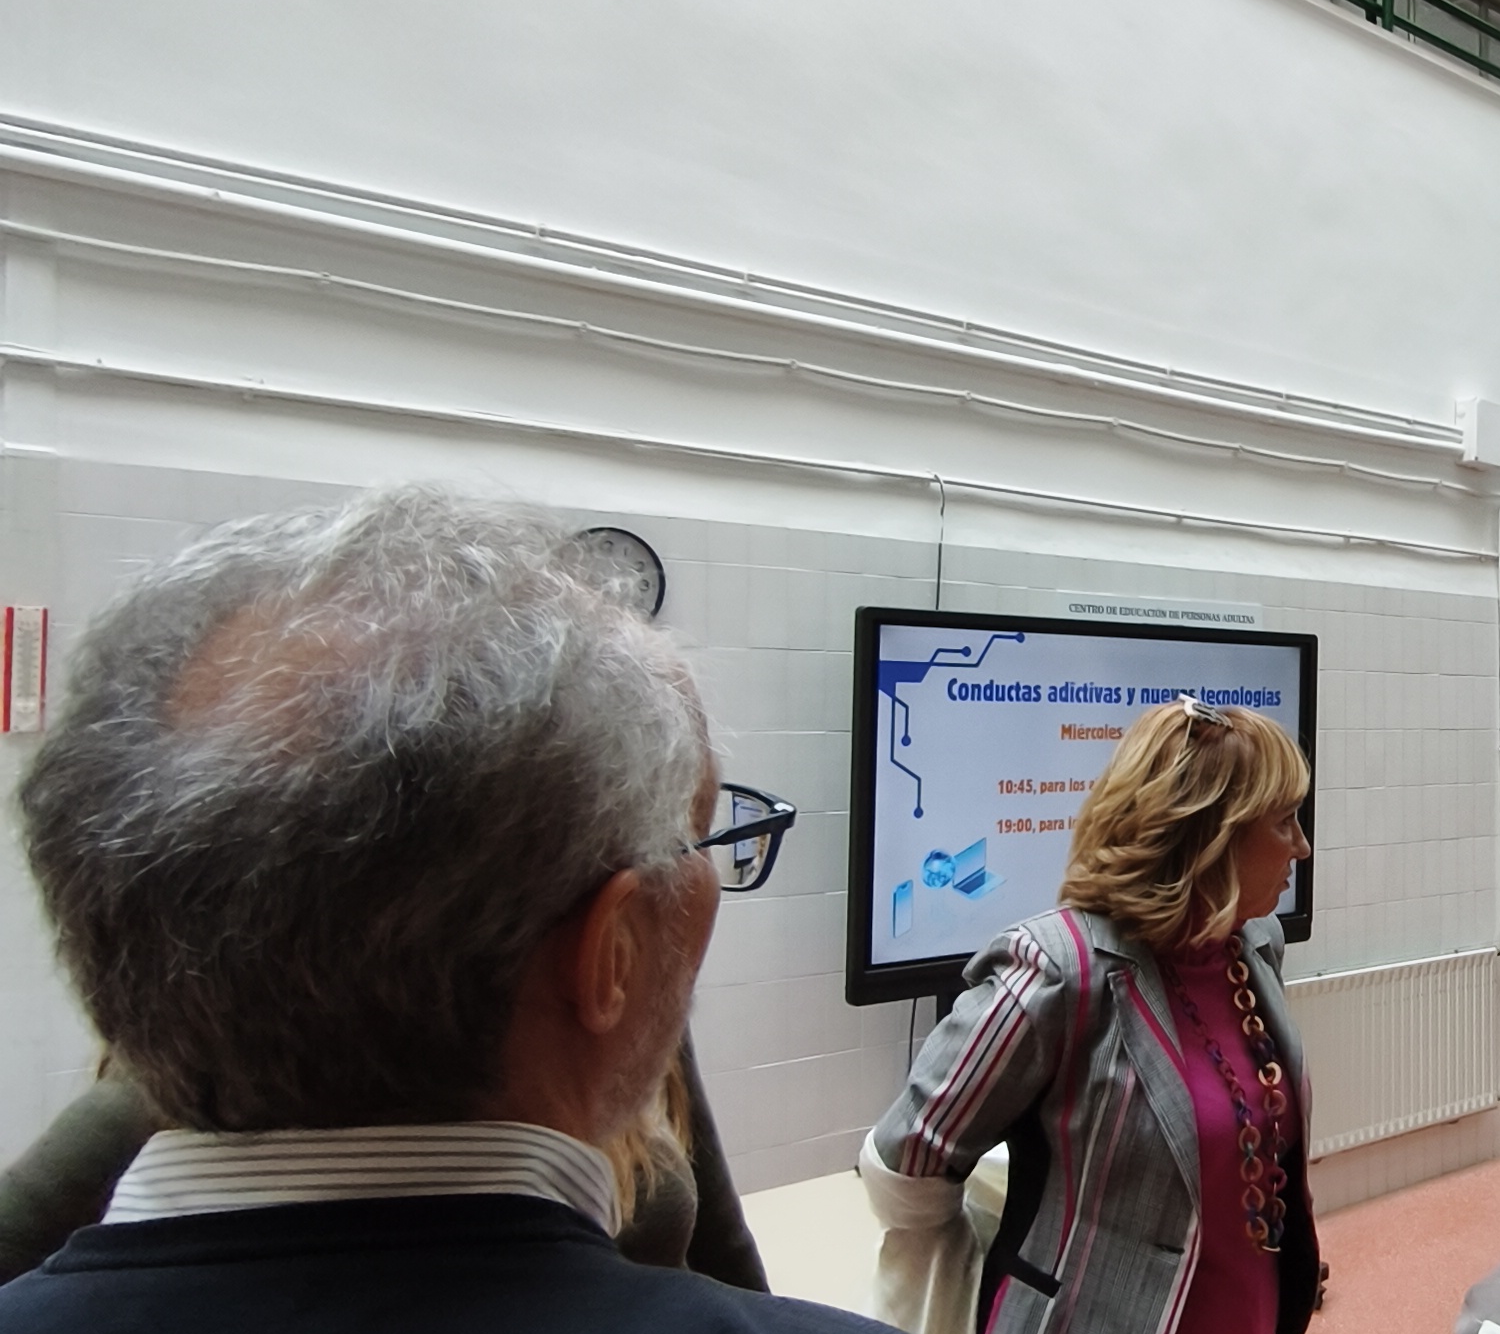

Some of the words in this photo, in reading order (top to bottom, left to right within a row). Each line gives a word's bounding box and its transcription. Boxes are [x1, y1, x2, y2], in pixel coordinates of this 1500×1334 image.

[1068, 603, 1105, 615] CENTRO
[1106, 606, 1118, 616] DE
[1181, 611, 1221, 623] PERSONAS
[1222, 614, 1255, 625] ADULTAS
[947, 678, 1042, 703] Conductas
[1047, 681, 1122, 705] adictivas
[1126, 686, 1136, 706] y
[1199, 685, 1281, 708] tecnologías
[1060, 723, 1123, 741] Miércoles
[998, 779, 1037, 795] 10:45,
[1039, 780, 1066, 794] para
[1069, 777, 1085, 792] los
[996, 818, 1036, 834] 19:00,
[1039, 819, 1065, 833] para
